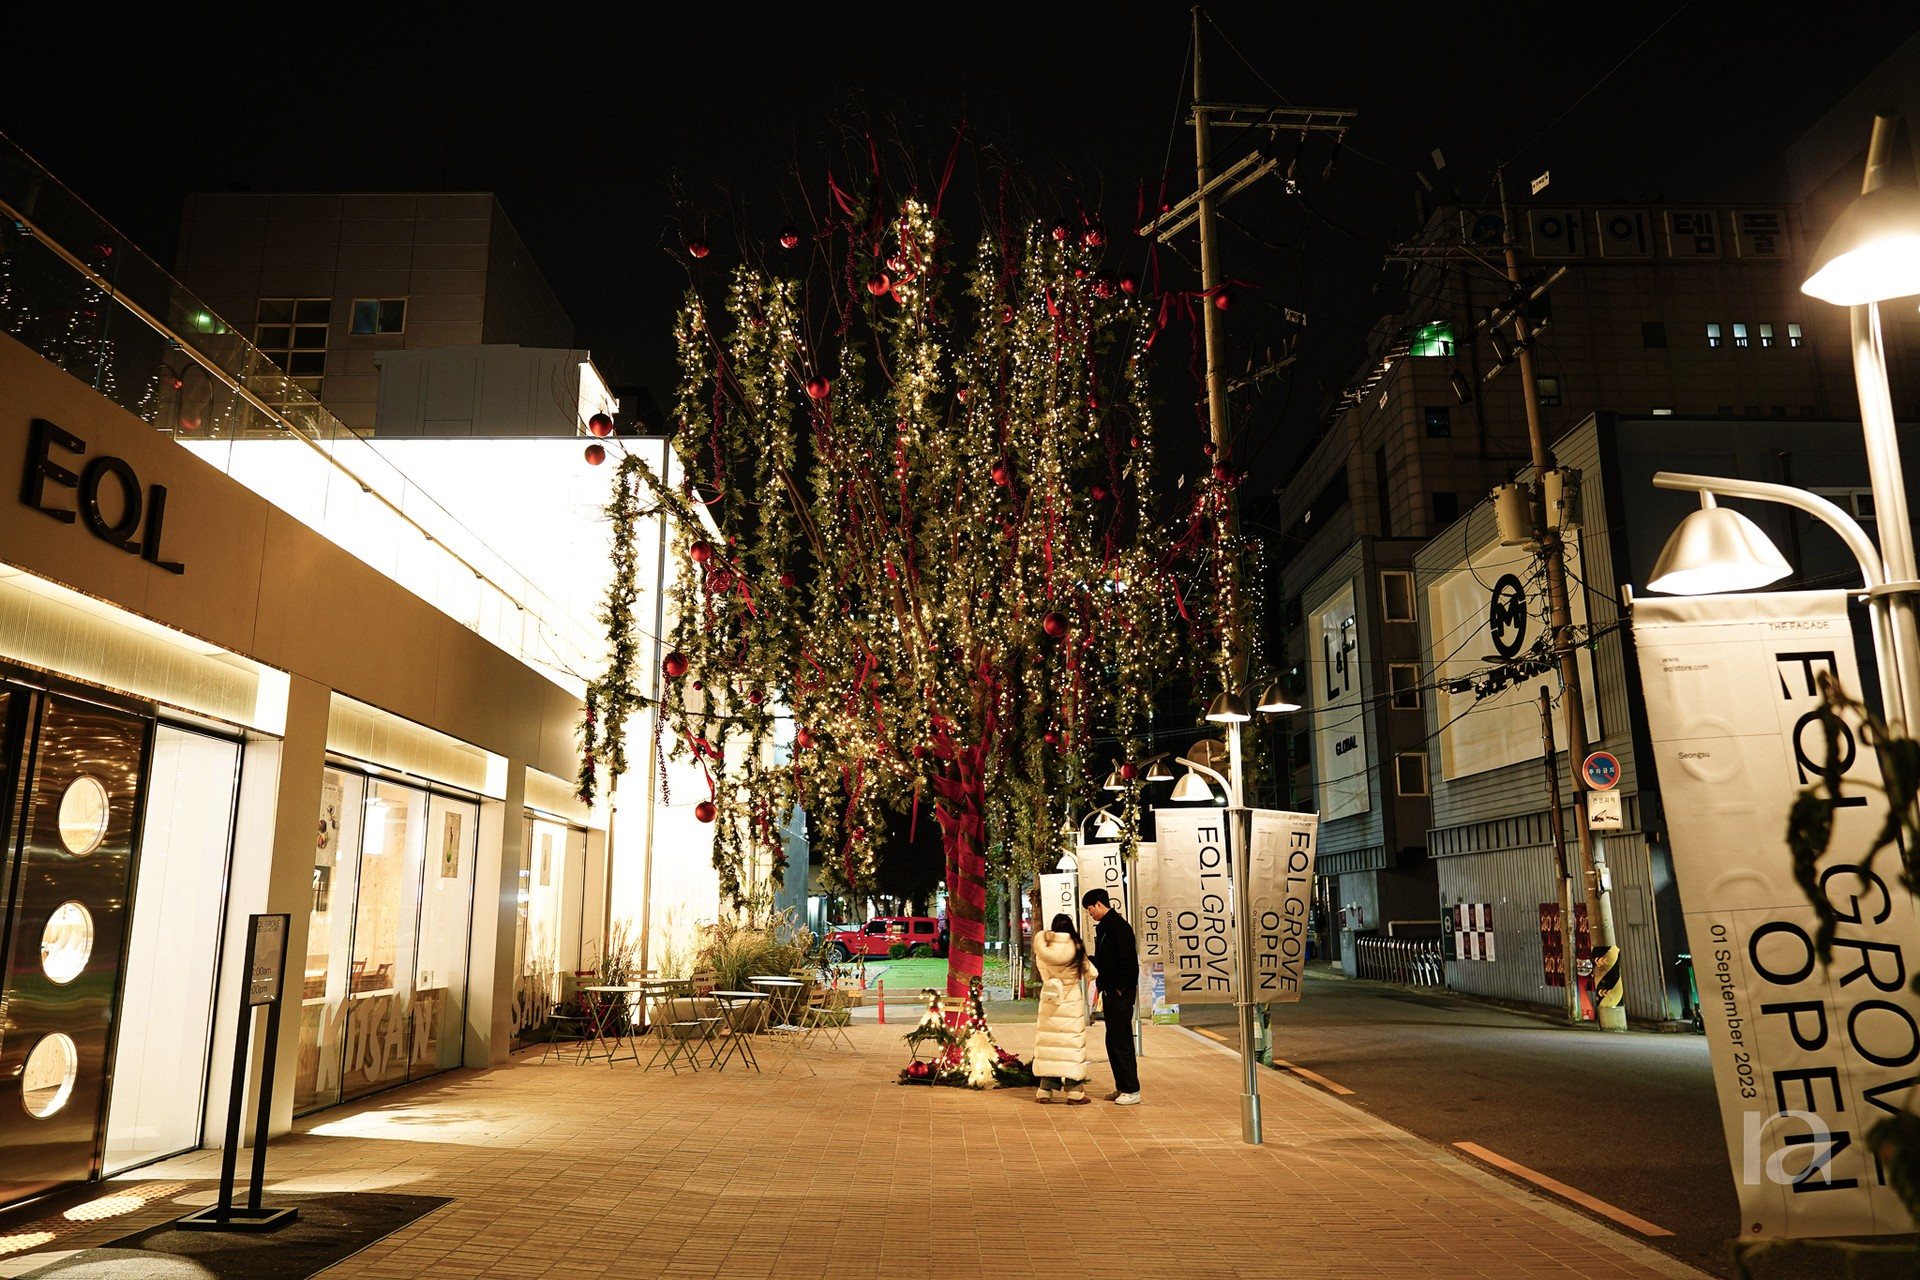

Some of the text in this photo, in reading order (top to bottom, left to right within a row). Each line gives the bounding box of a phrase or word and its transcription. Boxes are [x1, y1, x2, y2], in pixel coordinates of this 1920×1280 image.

[20, 418, 185, 574] EQL
[1790, 621, 1830, 631] FACADE
[1589, 766, 1615, 775] 주차금지
[1677, 751, 1711, 760] Seongsu
[1198, 827, 1222, 891] EQL
[1145, 906, 1159, 956] OPEN
[1177, 911, 1202, 992] OPEN
[1201, 894, 1231, 993] GROVE
[1260, 911, 1280, 989] OPEN
[1280, 831, 1311, 993] EQL GROVE
[1711, 924, 1757, 1099] 01 September 2023
[1819, 864, 1920, 1186] GROV
[1749, 921, 1860, 1193] OPEN
